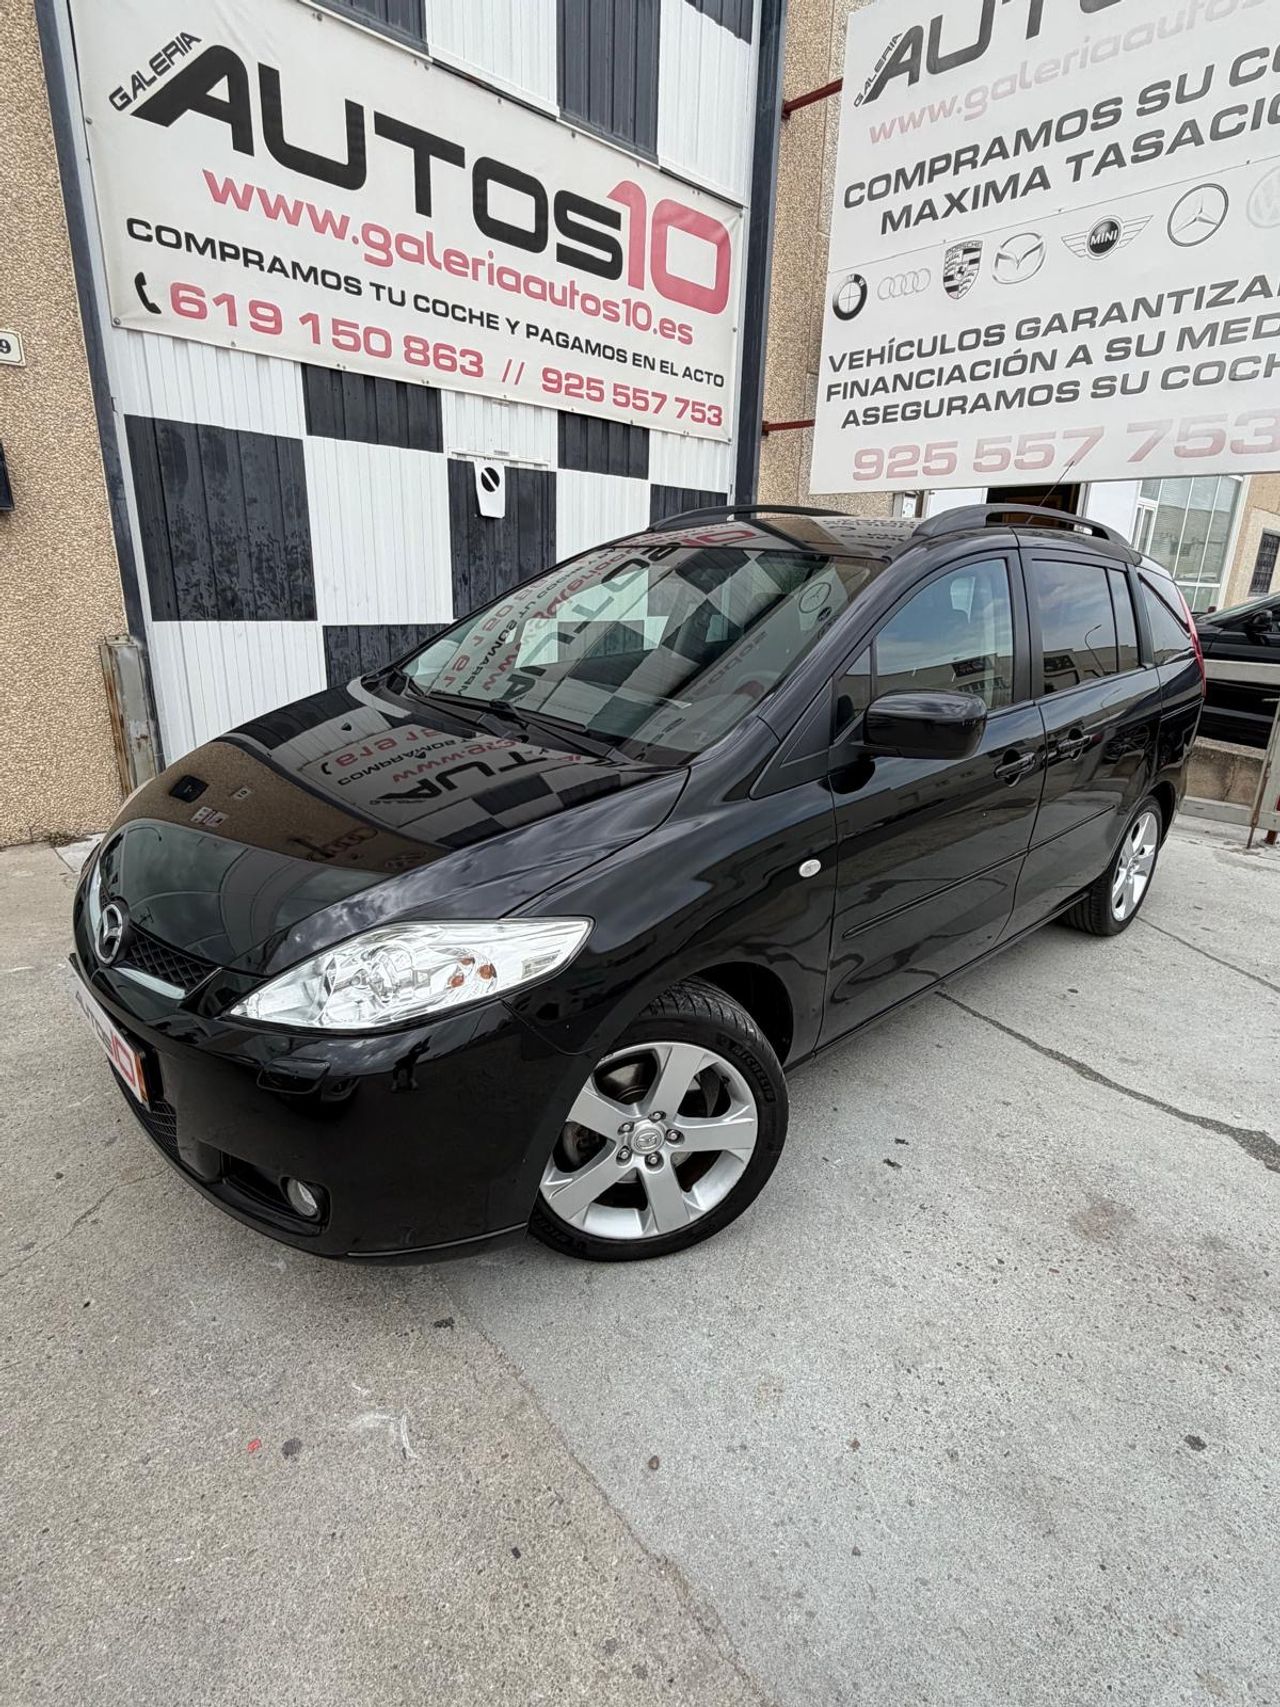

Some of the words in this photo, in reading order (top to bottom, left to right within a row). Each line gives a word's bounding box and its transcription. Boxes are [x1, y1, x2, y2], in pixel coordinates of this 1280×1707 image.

[108, 31, 202, 112] GALERIA
[853, 32, 903, 108] GALERIA
[843, 96, 1124, 209] COMPRAMOS
[1136, 63, 1215, 117] SU
[1229, 44, 1280, 88] C
[880, 164, 1052, 235] MAXIMA
[1089, 229, 1118, 246] MINI
[201, 168, 694, 346] www.galeriaautos10.es
[126, 217, 363, 297] COMPRAMOS
[369, 281, 407, 308] TU
[412, 293, 500, 331] COCHE
[505, 317, 521, 336] Y
[525, 322, 628, 364] PAGAMOS
[632, 352, 656, 371] EN
[659, 360, 679, 377] EL
[681, 367, 725, 389] ACTO
[828, 322, 1006, 373] VEHÍCULOS
[1014, 274, 1280, 341] GARANTIZA
[169, 281, 284, 337] 619
[299, 311, 393, 360] 150
[402, 334, 485, 379] 863
[541, 366, 605, 403] 925
[612, 382, 668, 416] 557
[673, 395, 724, 427] 753
[826, 347, 1058, 402] FINANCIACIÓN
[1065, 343, 1094, 369] A
[1104, 330, 1166, 362] SU
[840, 380, 1081, 429] ASEGURAMOS
[1090, 370, 1150, 400] SU
[852, 440, 959, 481] 925
[972, 425, 1105, 474] 557
[1126, 408, 1280, 463] 753
